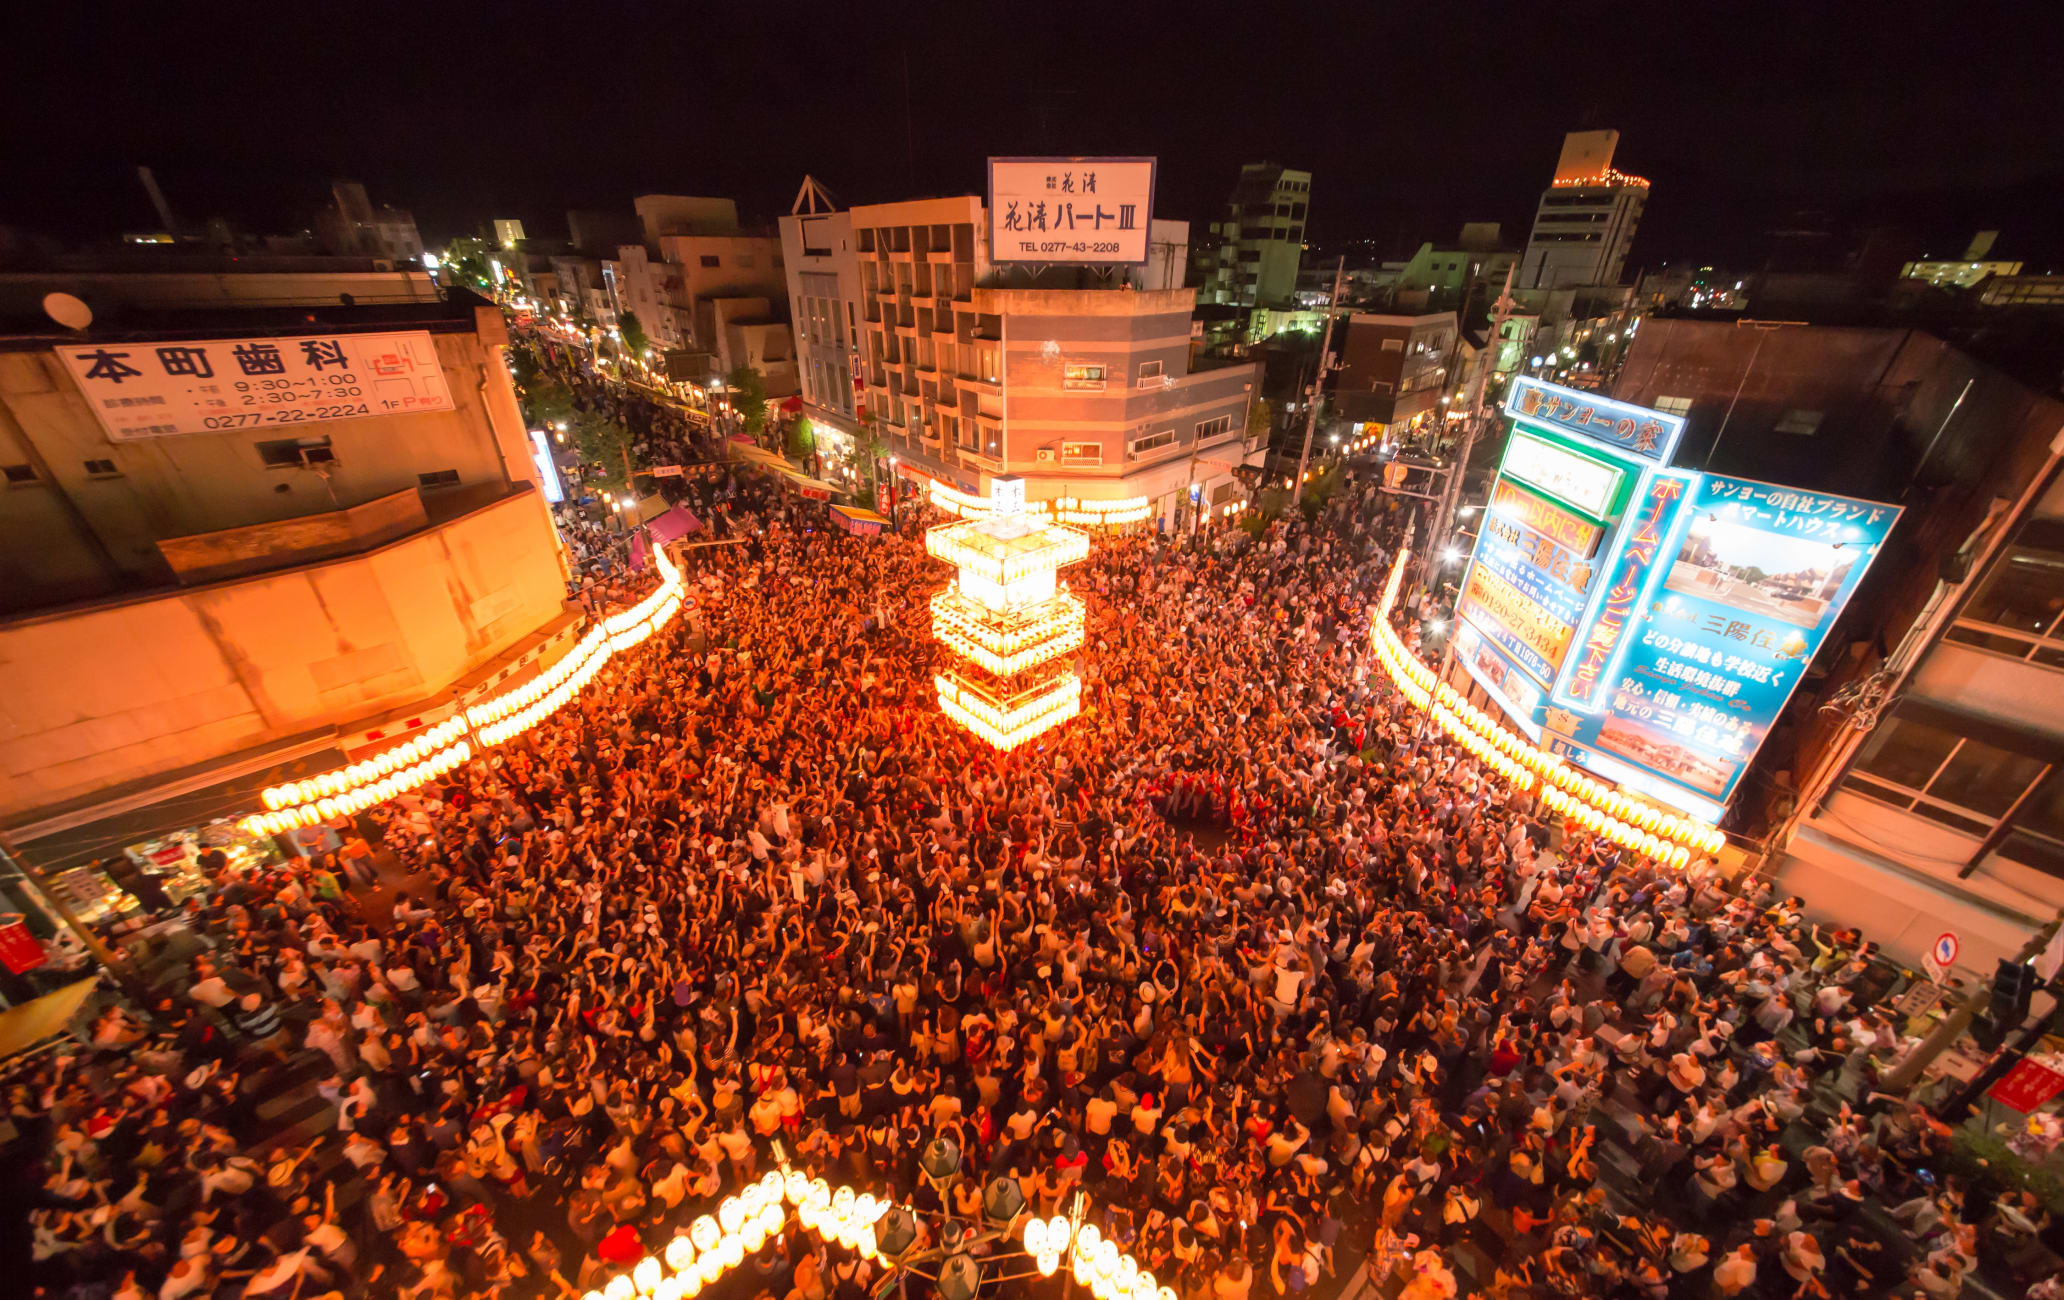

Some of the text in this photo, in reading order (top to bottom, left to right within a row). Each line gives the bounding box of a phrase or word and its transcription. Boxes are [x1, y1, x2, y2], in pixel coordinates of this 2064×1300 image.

[1062, 170, 1096, 194] 花清
[1019, 242, 1120, 253] TEL 0277-43-2208
[76, 340, 348, 383] 本町歯科
[203, 403, 370, 429] 0277-22-2224
[381, 399, 400, 409] 1F
[1545, 396, 1665, 451] サンヨーの家
[1710, 480, 1886, 527] サンヨーの自社ブランド
[1569, 478, 1684, 700] ホームページご覧下さい
